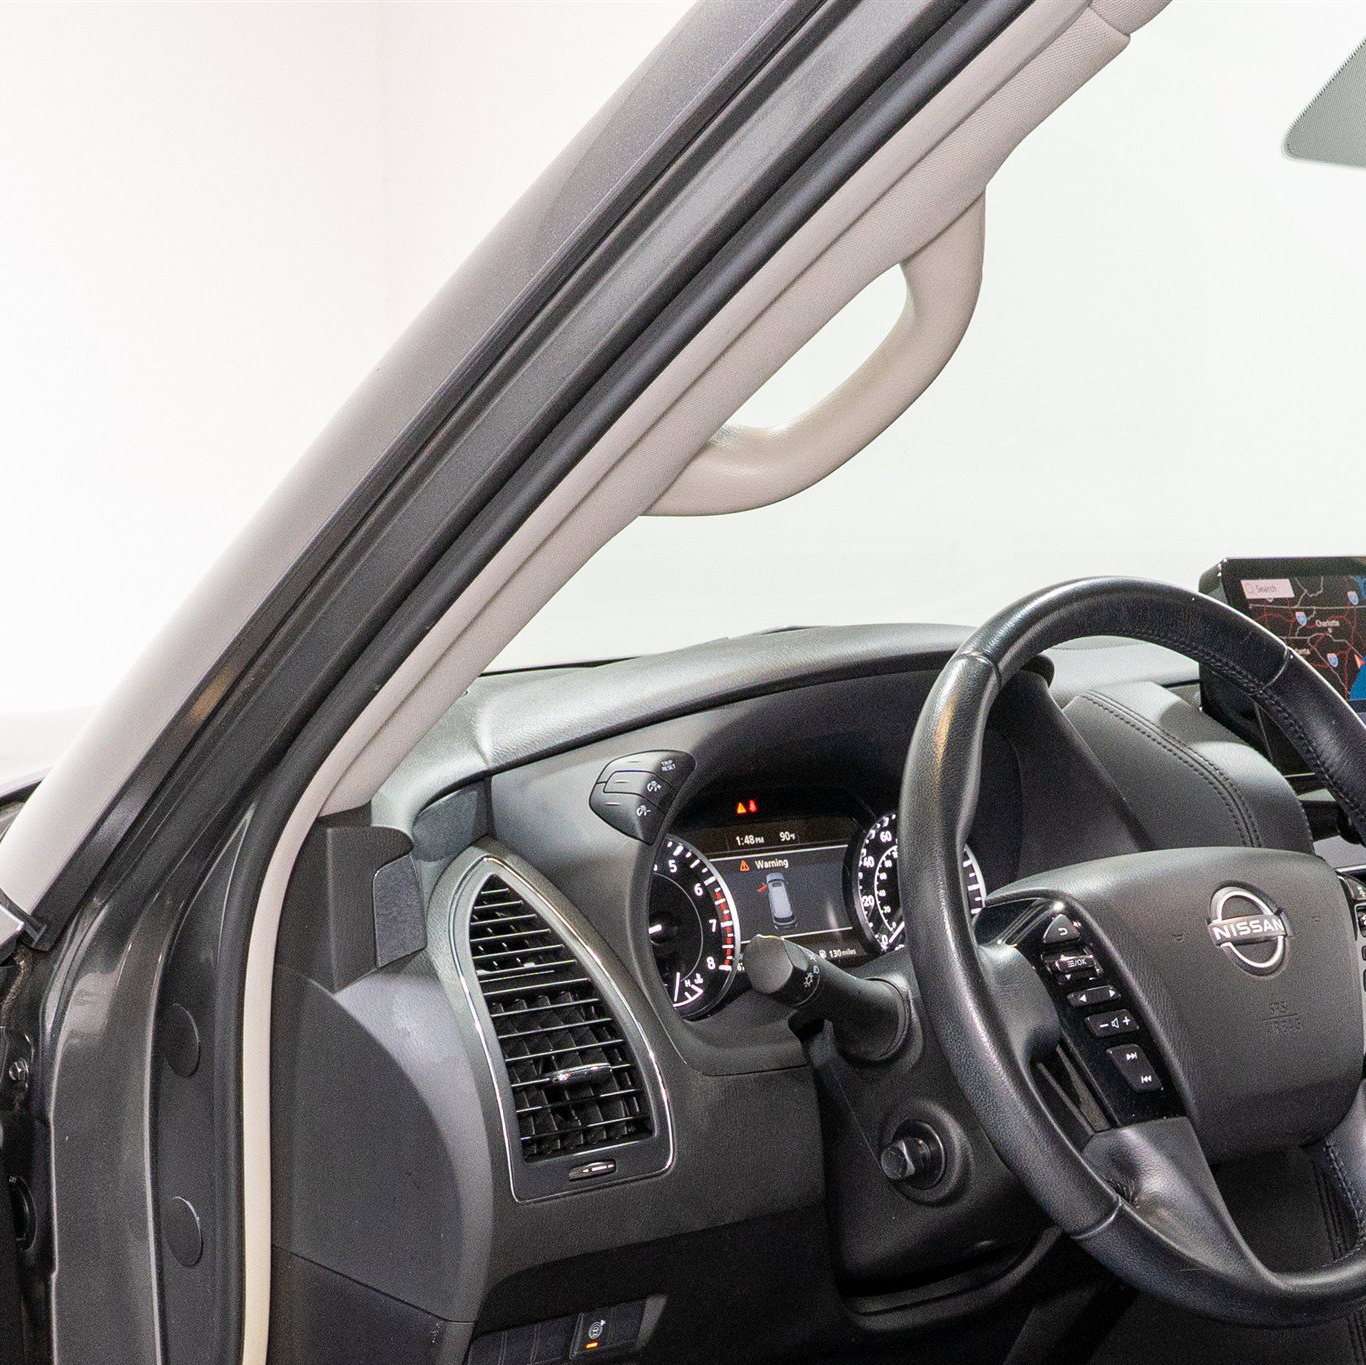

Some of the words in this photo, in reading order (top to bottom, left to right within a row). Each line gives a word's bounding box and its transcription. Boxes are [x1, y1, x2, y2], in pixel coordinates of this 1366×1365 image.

[880, 831, 892, 843] 60
[668, 860, 677, 873] 5
[755, 858, 789, 869] Warning
[863, 856, 875, 868] 40
[694, 883, 703, 896] 6
[862, 895, 875, 907] 20
[708, 919, 717, 932] 7
[1212, 919, 1285, 940] NISSAN
[829, 948, 841, 958] 130
[706, 956, 716, 970] 8
